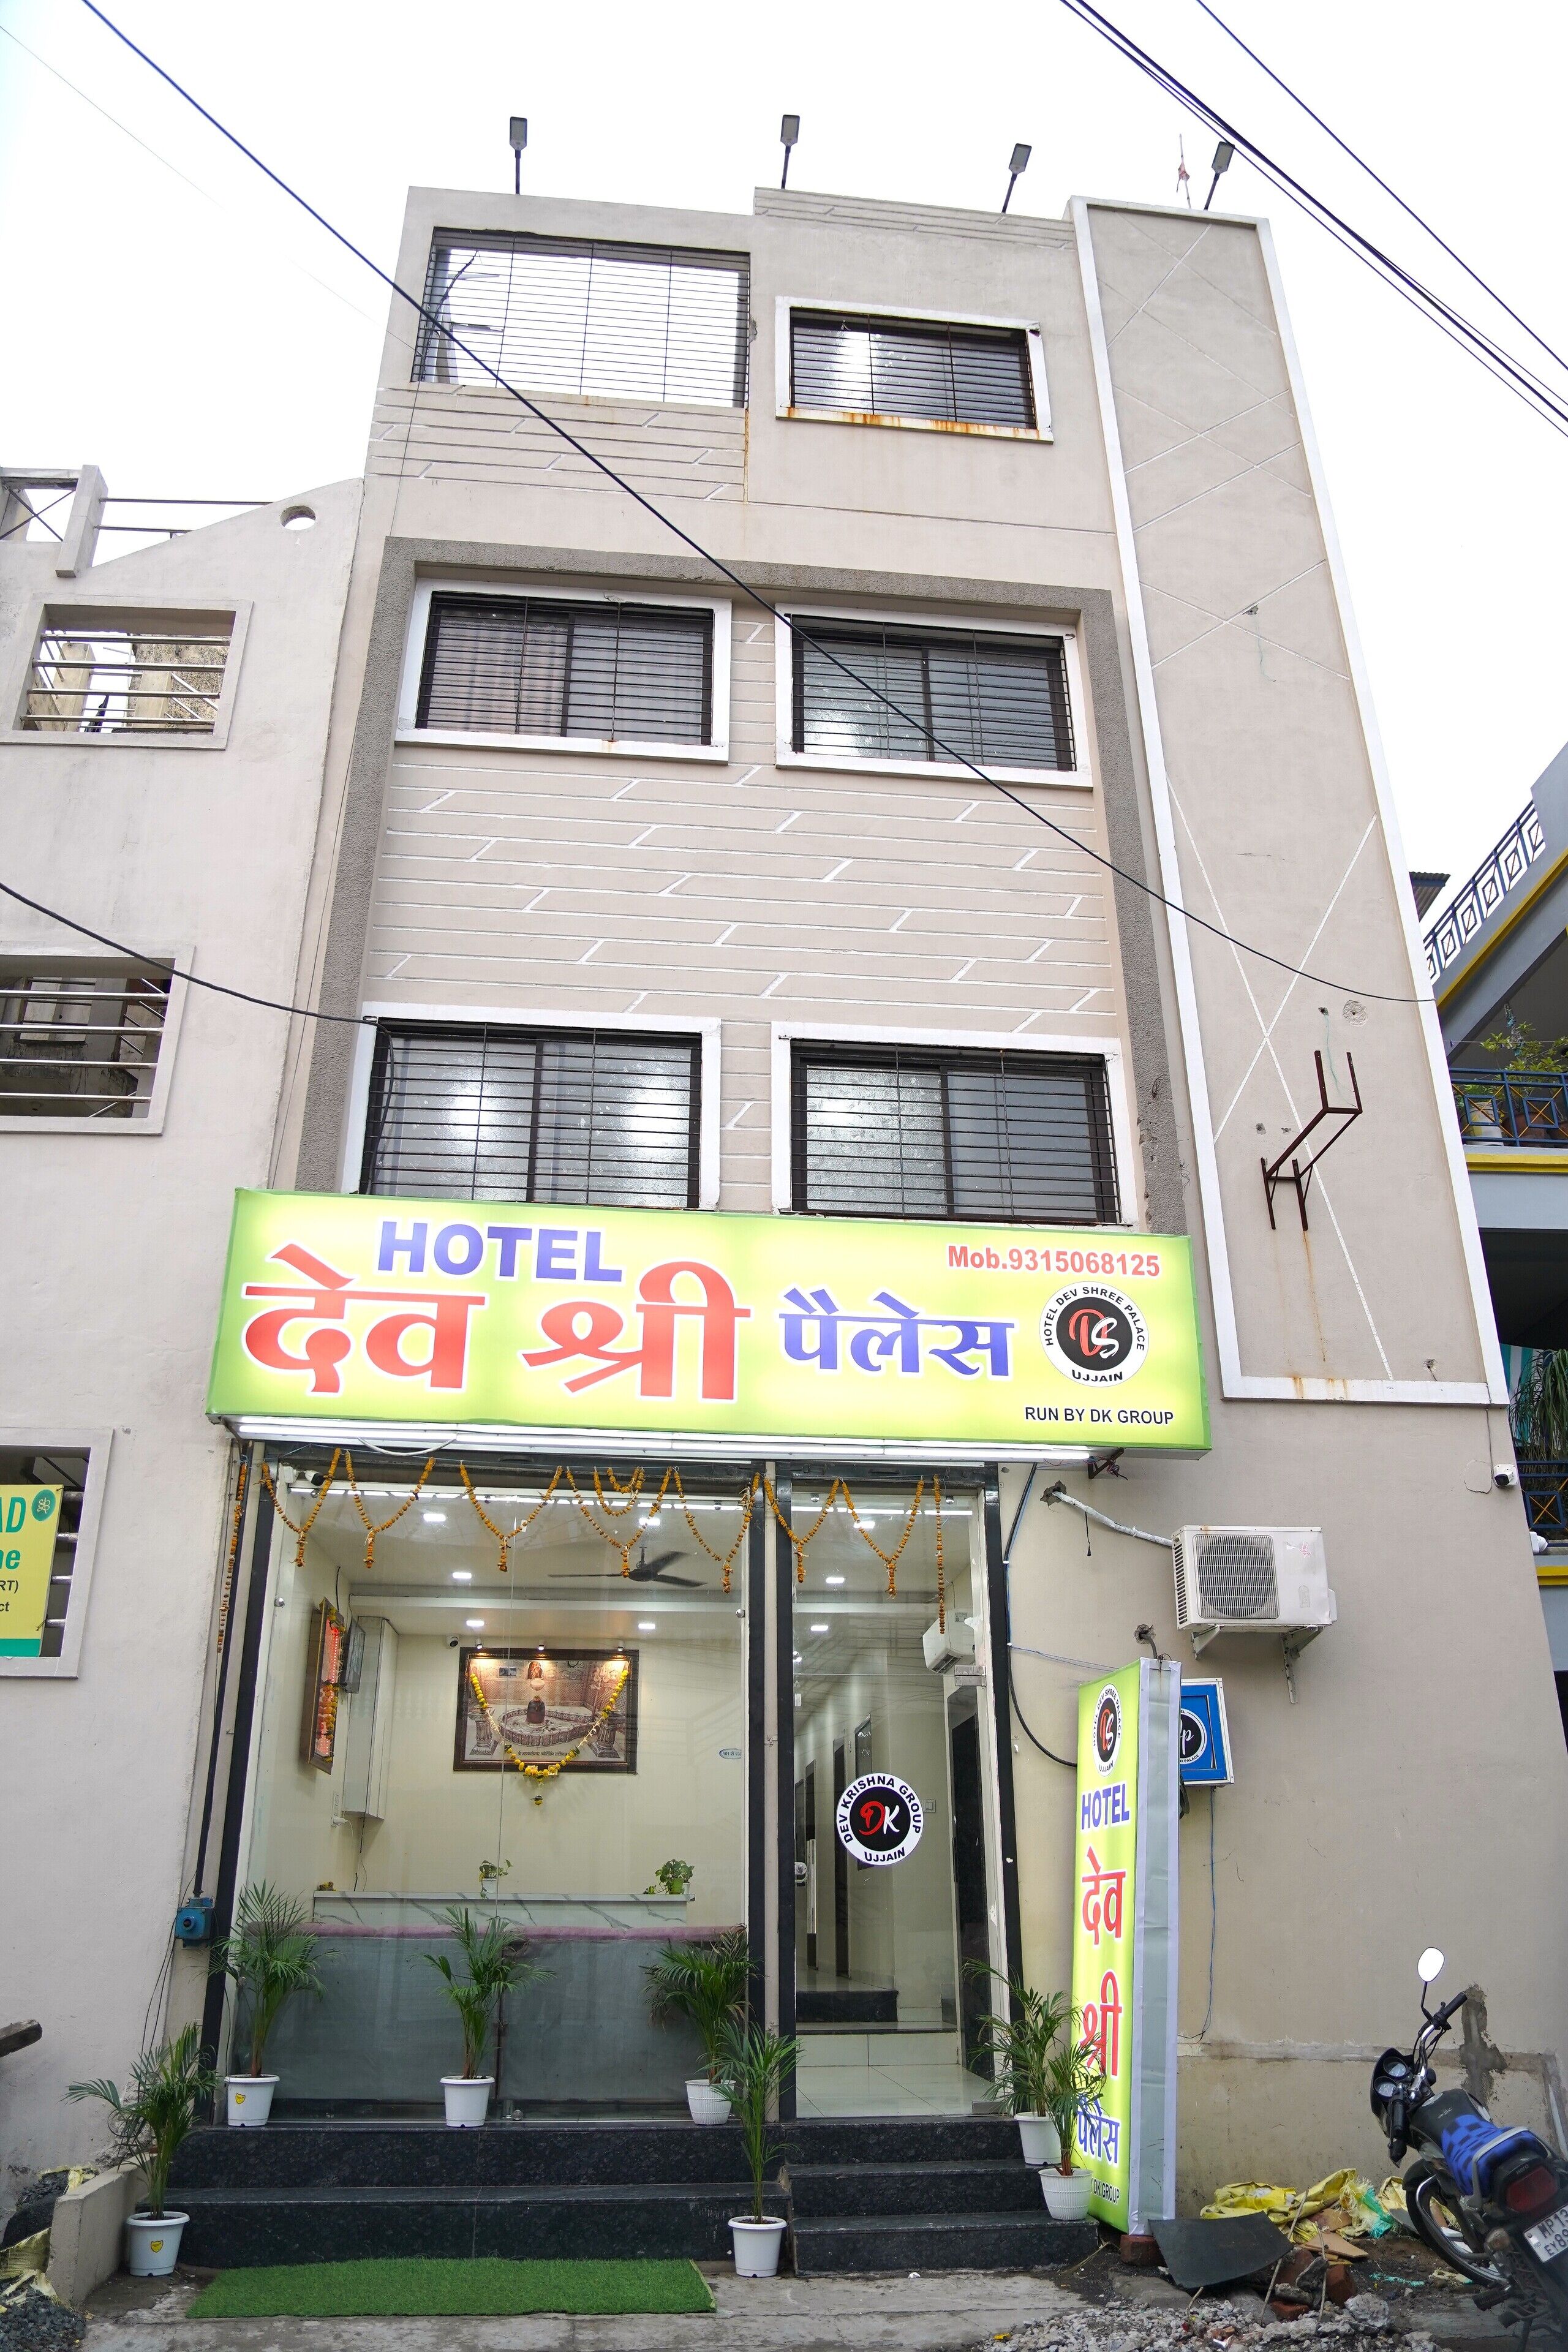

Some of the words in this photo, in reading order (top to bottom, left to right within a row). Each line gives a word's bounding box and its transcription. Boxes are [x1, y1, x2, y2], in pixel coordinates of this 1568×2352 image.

[378, 1221, 622, 1282] HOTEL
[948, 1245, 1159, 1276] Mob.9315068125
[246, 1243, 485, 1393] देव
[522, 1261, 751, 1400] श्री
[779, 1287, 1014, 1376] पैलेस
[1044, 1308, 1058, 1346] HOTEL
[1056, 1289, 1077, 1306] DEV
[1082, 1286, 1124, 1305] SHREE
[1124, 1304, 1145, 1351] PALACE
[1072, 1370, 1123, 1382] UJJAIN
[1025, 1407, 1058, 1420] RUN
[1065, 1408, 1085, 1421] BY
[1090, 1409, 1112, 1422] DK
[1117, 1410, 1174, 1424] GROUP
[1105, 1688, 1117, 1700] SHREE
[1099, 1760, 1114, 1772] UJJAIN
[1184, 1754, 1199, 1763] PALACE
[841, 1776, 895, 1809] KRISHNA
[1081, 1784, 1129, 1830] HOTEL
[859, 1801, 900, 1835] DK
[899, 1785, 922, 1834] GROUP
[839, 1814, 854, 1843] DEV
[864, 1847, 905, 1862] UJJAIN
[1082, 1845, 1126, 1945] देव
[1080, 1971, 1122, 2076] श्री
[1094, 2179, 1101, 2196] DK
[1102, 2182, 1120, 2204] GROUP
